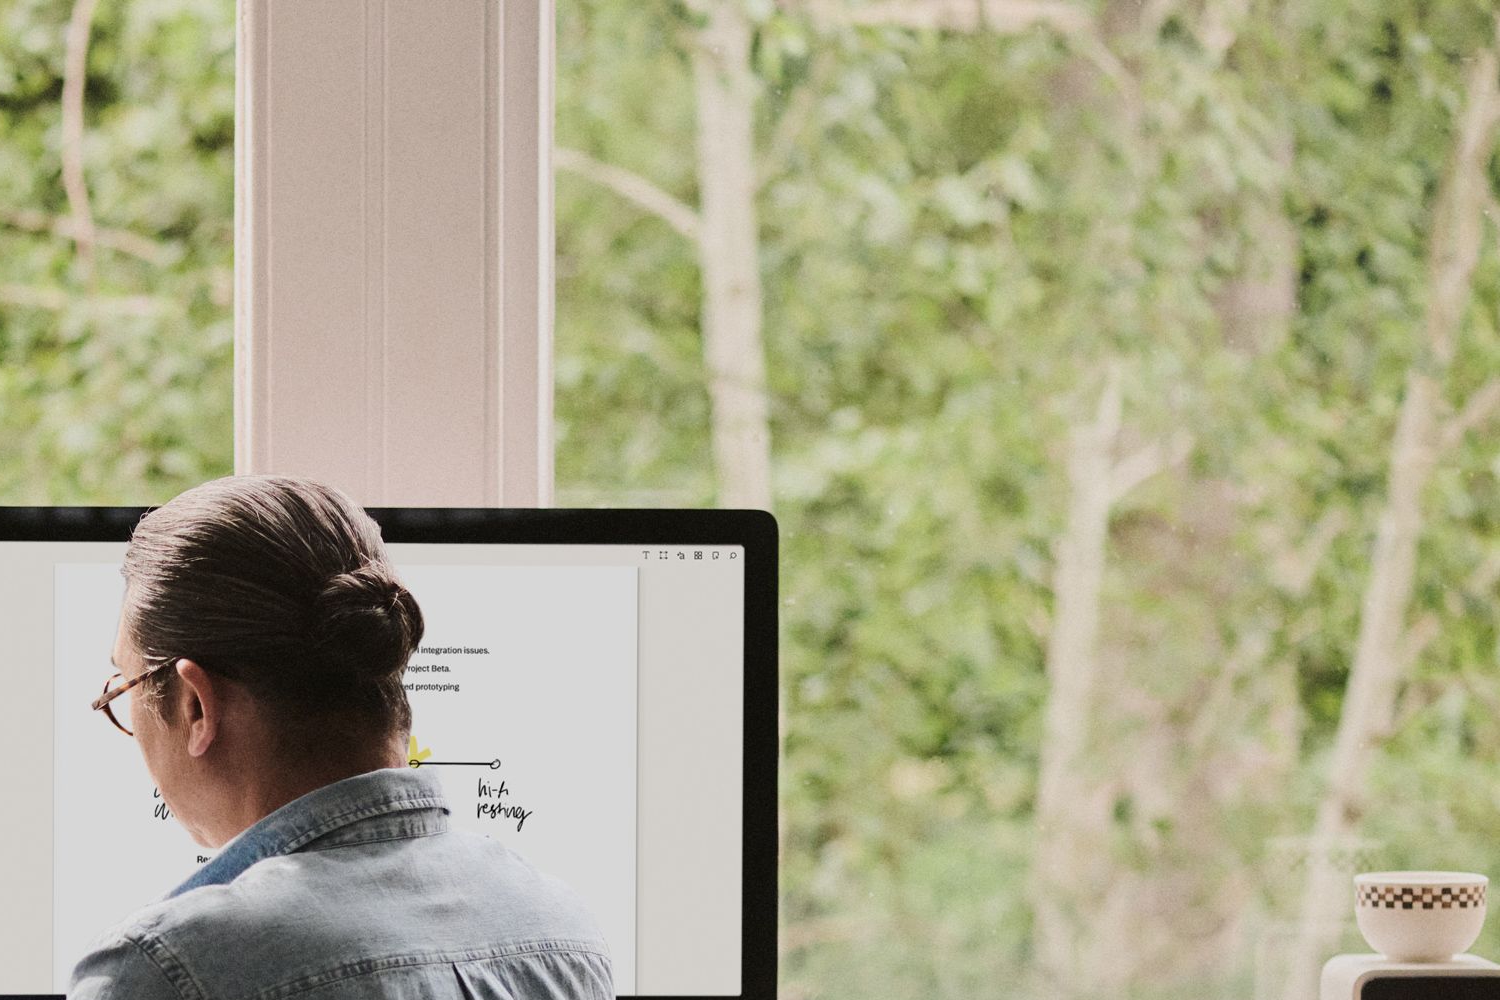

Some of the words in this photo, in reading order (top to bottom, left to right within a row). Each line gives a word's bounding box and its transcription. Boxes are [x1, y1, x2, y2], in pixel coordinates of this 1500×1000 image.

[421, 646, 462, 655] integration
[463, 646, 489, 654] issues.
[406, 665, 430, 673] roject
[431, 665, 451, 673] Beta.
[415, 683, 460, 692] prototyping
